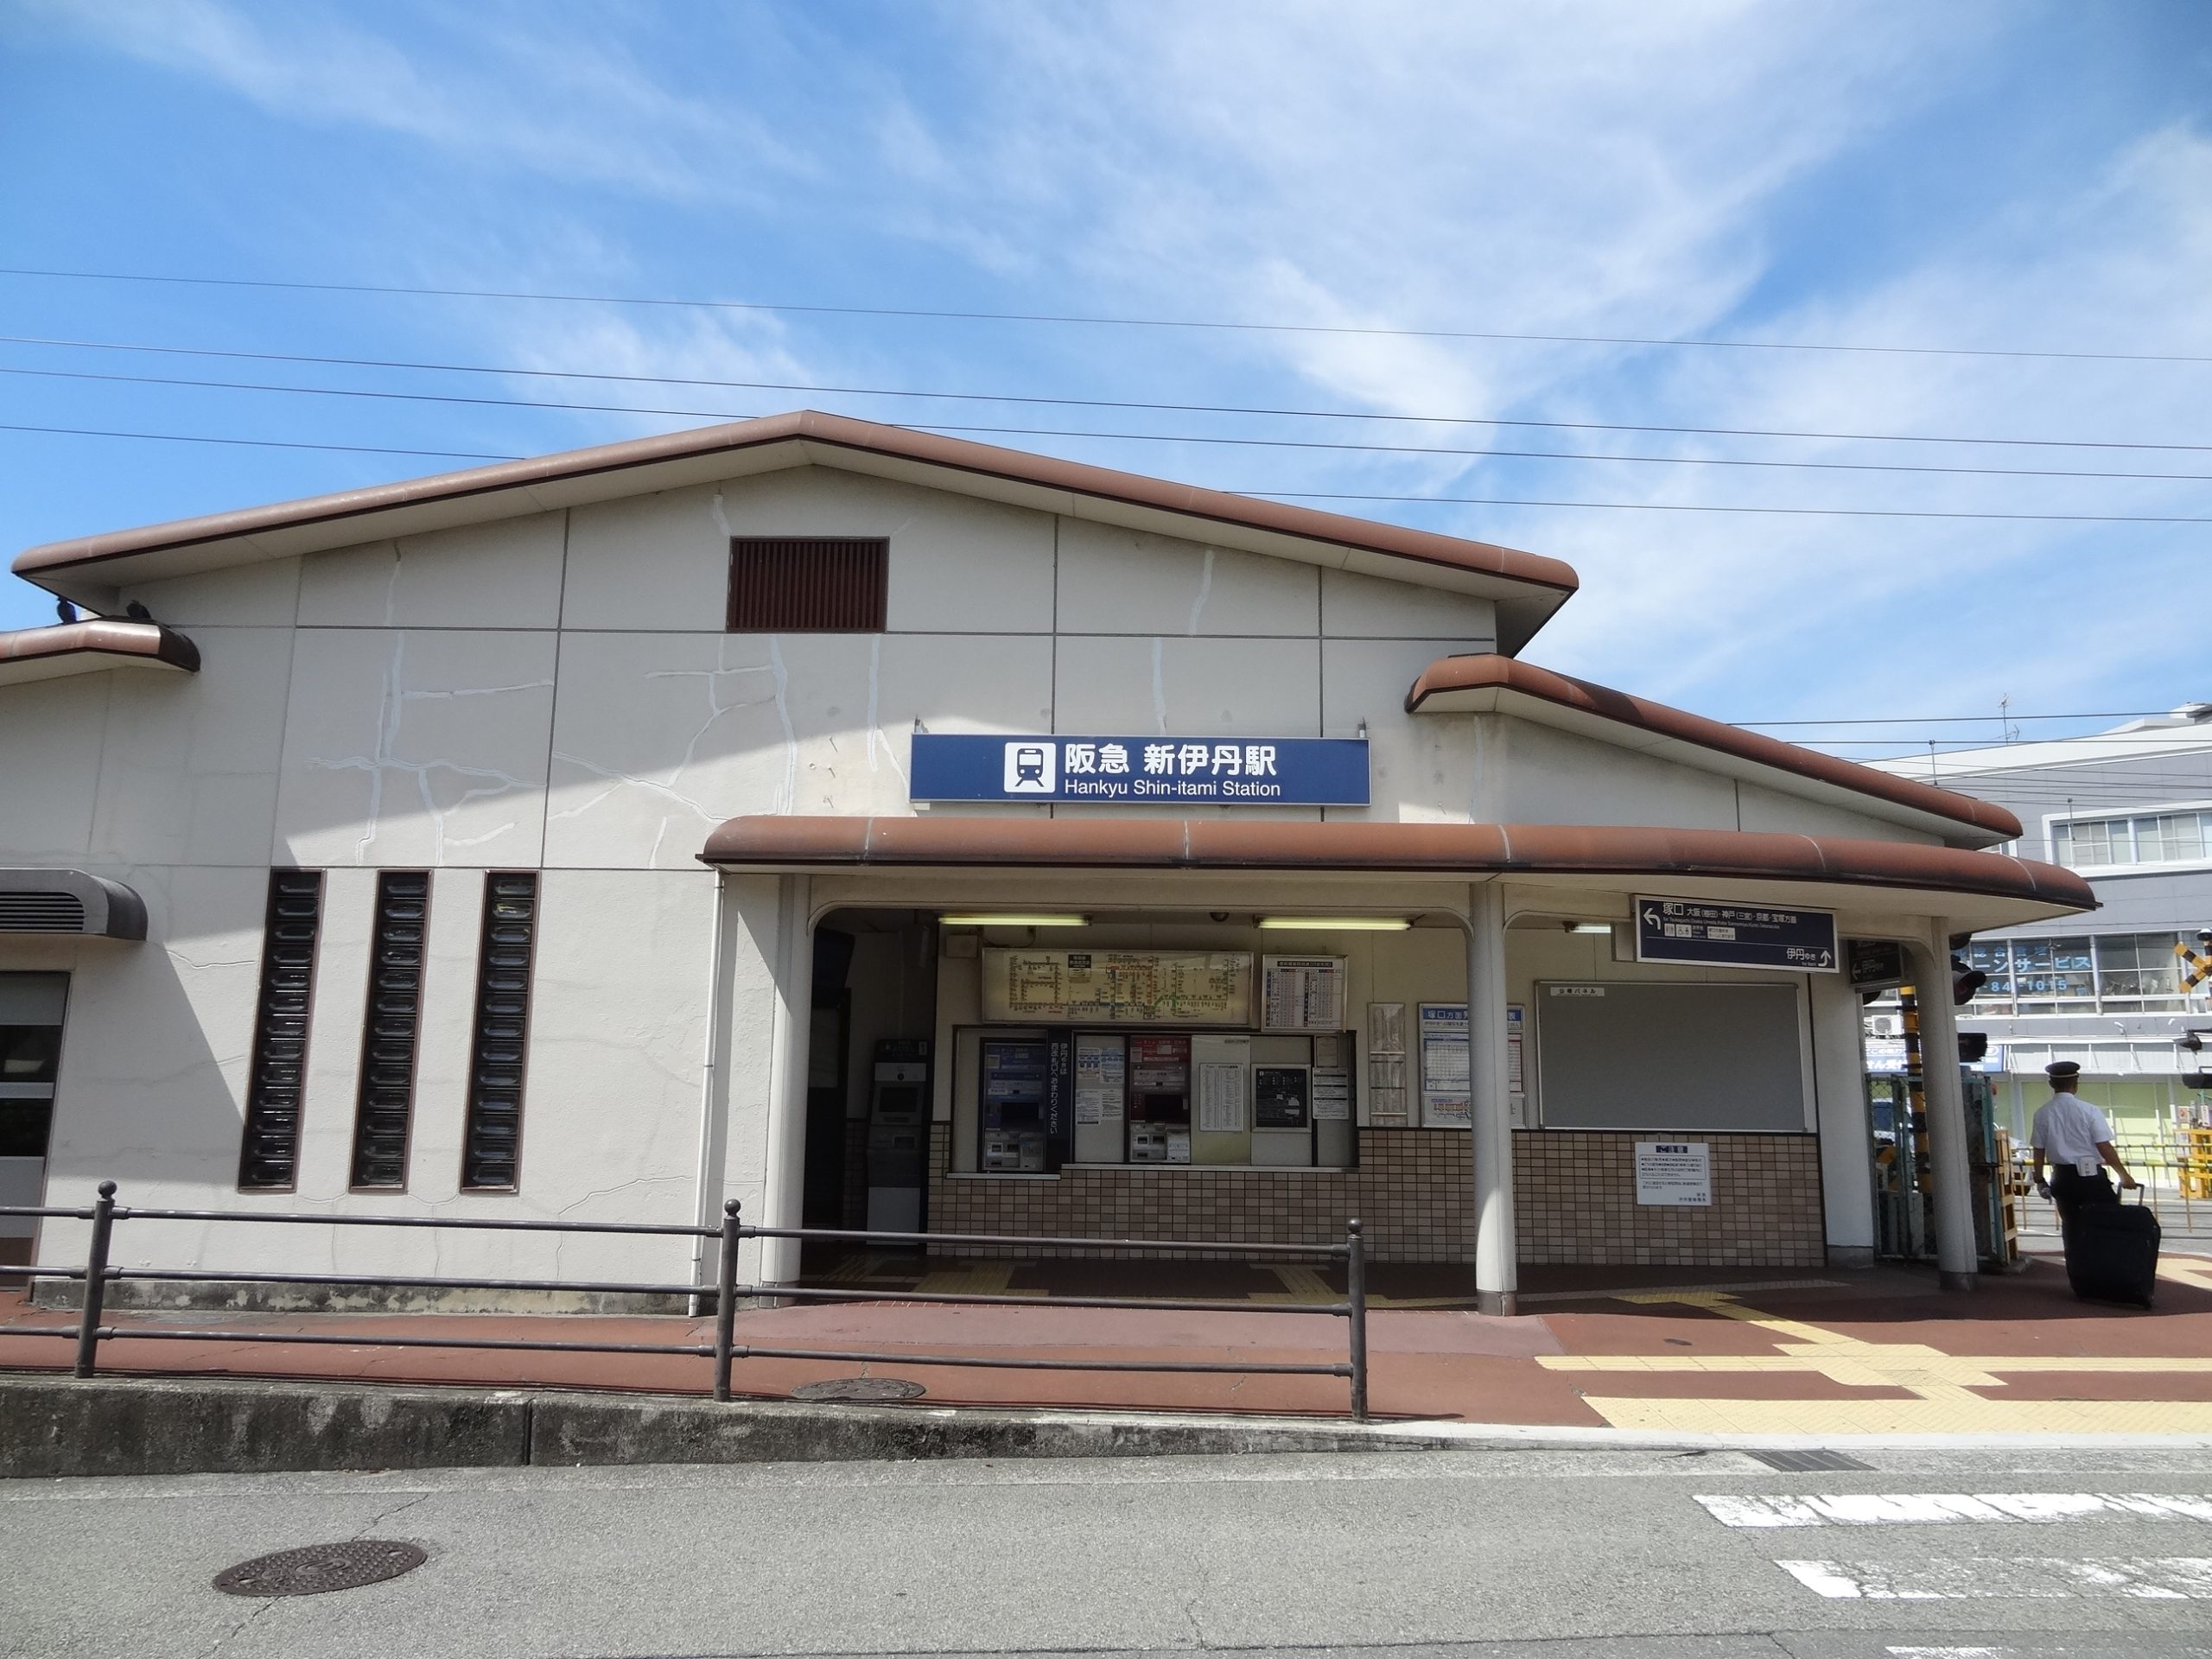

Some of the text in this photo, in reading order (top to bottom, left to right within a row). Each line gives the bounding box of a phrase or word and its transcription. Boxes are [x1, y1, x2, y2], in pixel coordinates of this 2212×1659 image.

[1065, 743, 1277, 777] 阪急 新伊丹駅
[1065, 779, 1281, 798] Hankyu Shin-itami Station
[1662, 902, 1684, 916] 塚口
